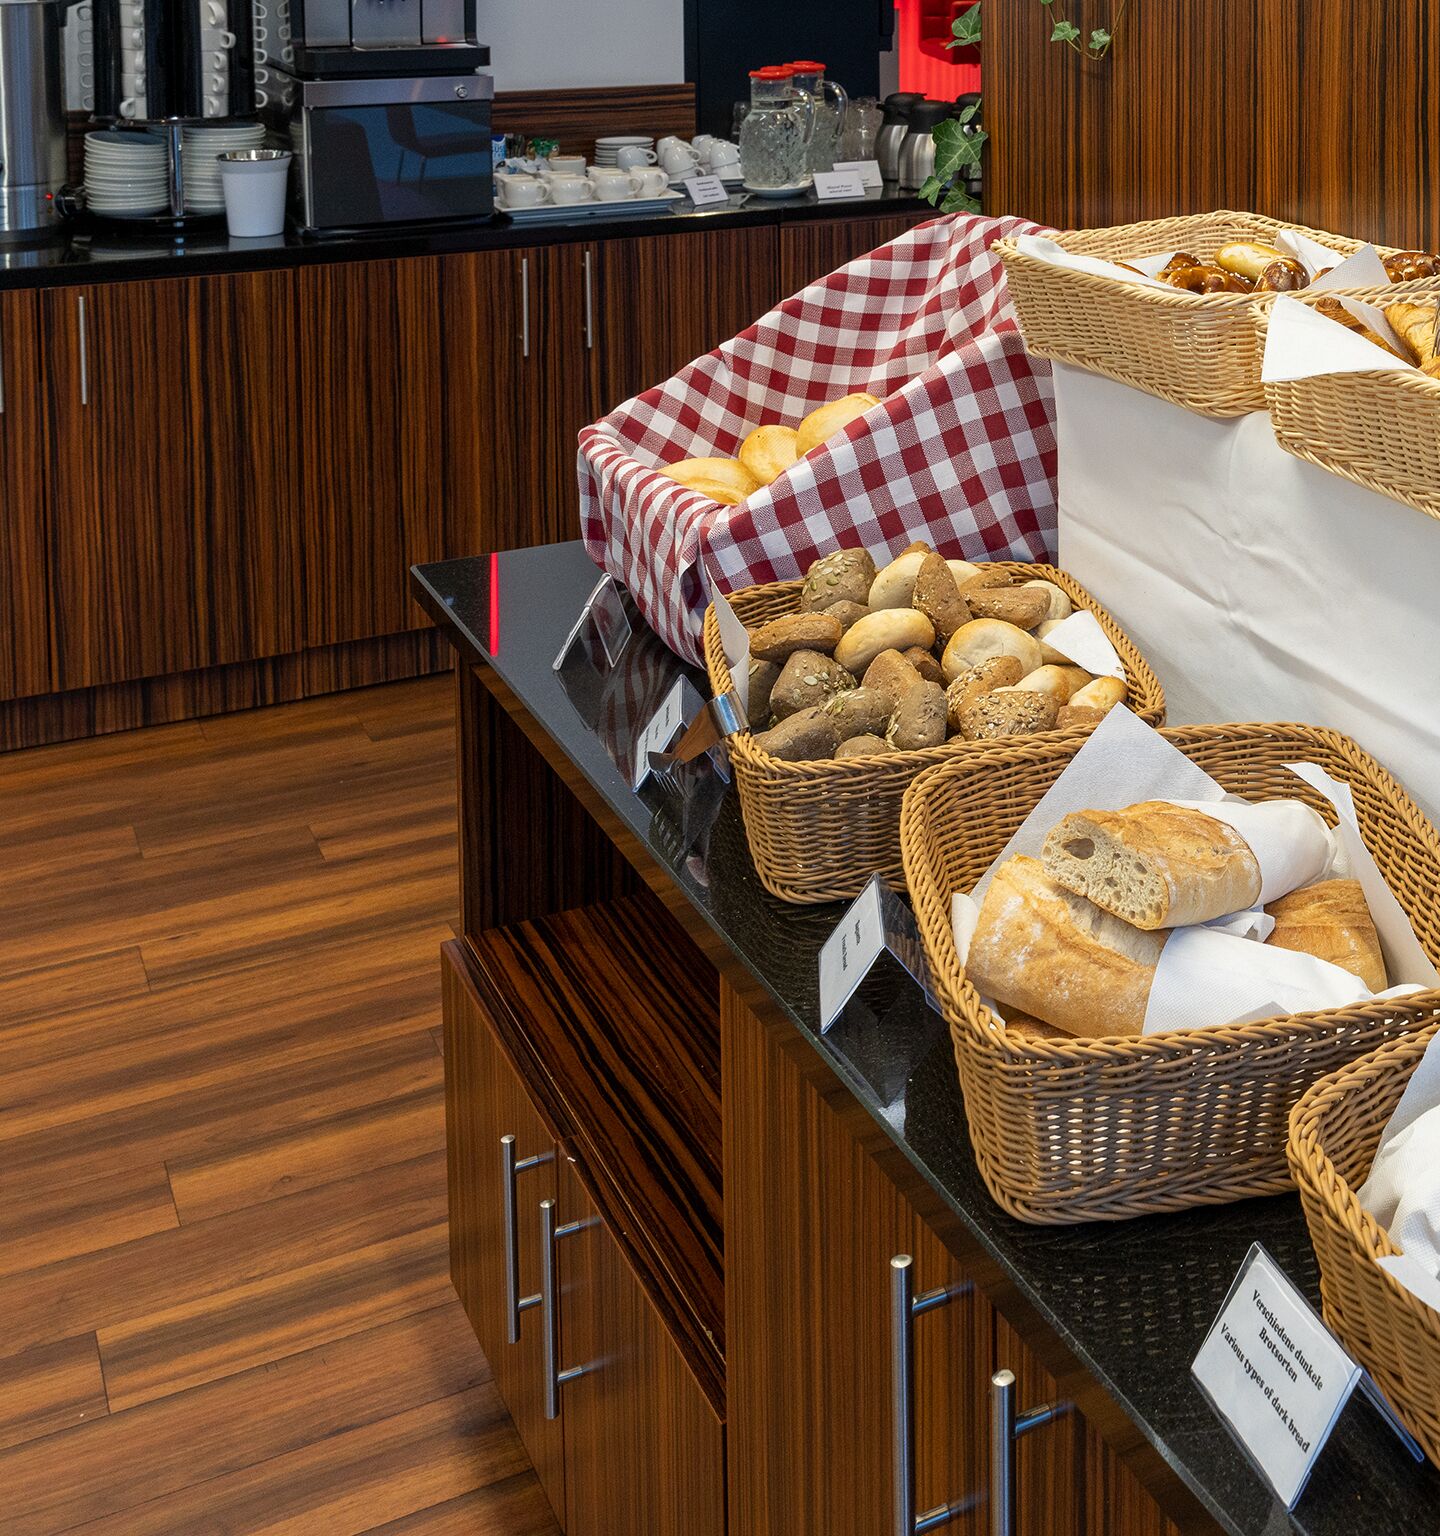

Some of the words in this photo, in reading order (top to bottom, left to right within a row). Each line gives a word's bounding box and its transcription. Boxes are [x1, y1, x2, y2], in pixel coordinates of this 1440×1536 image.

[1220, 1322, 1245, 1363] Various
[1243, 1358, 1265, 1389] types
[1263, 1386, 1275, 1400] of
[1271, 1397, 1290, 1424] dark
[1288, 1418, 1311, 1453] bread
[1252, 1289, 1296, 1353] Verschiedene
[1294, 1350, 1324, 1391] dunkele
[1258, 1326, 1298, 1383] Brotsorten
